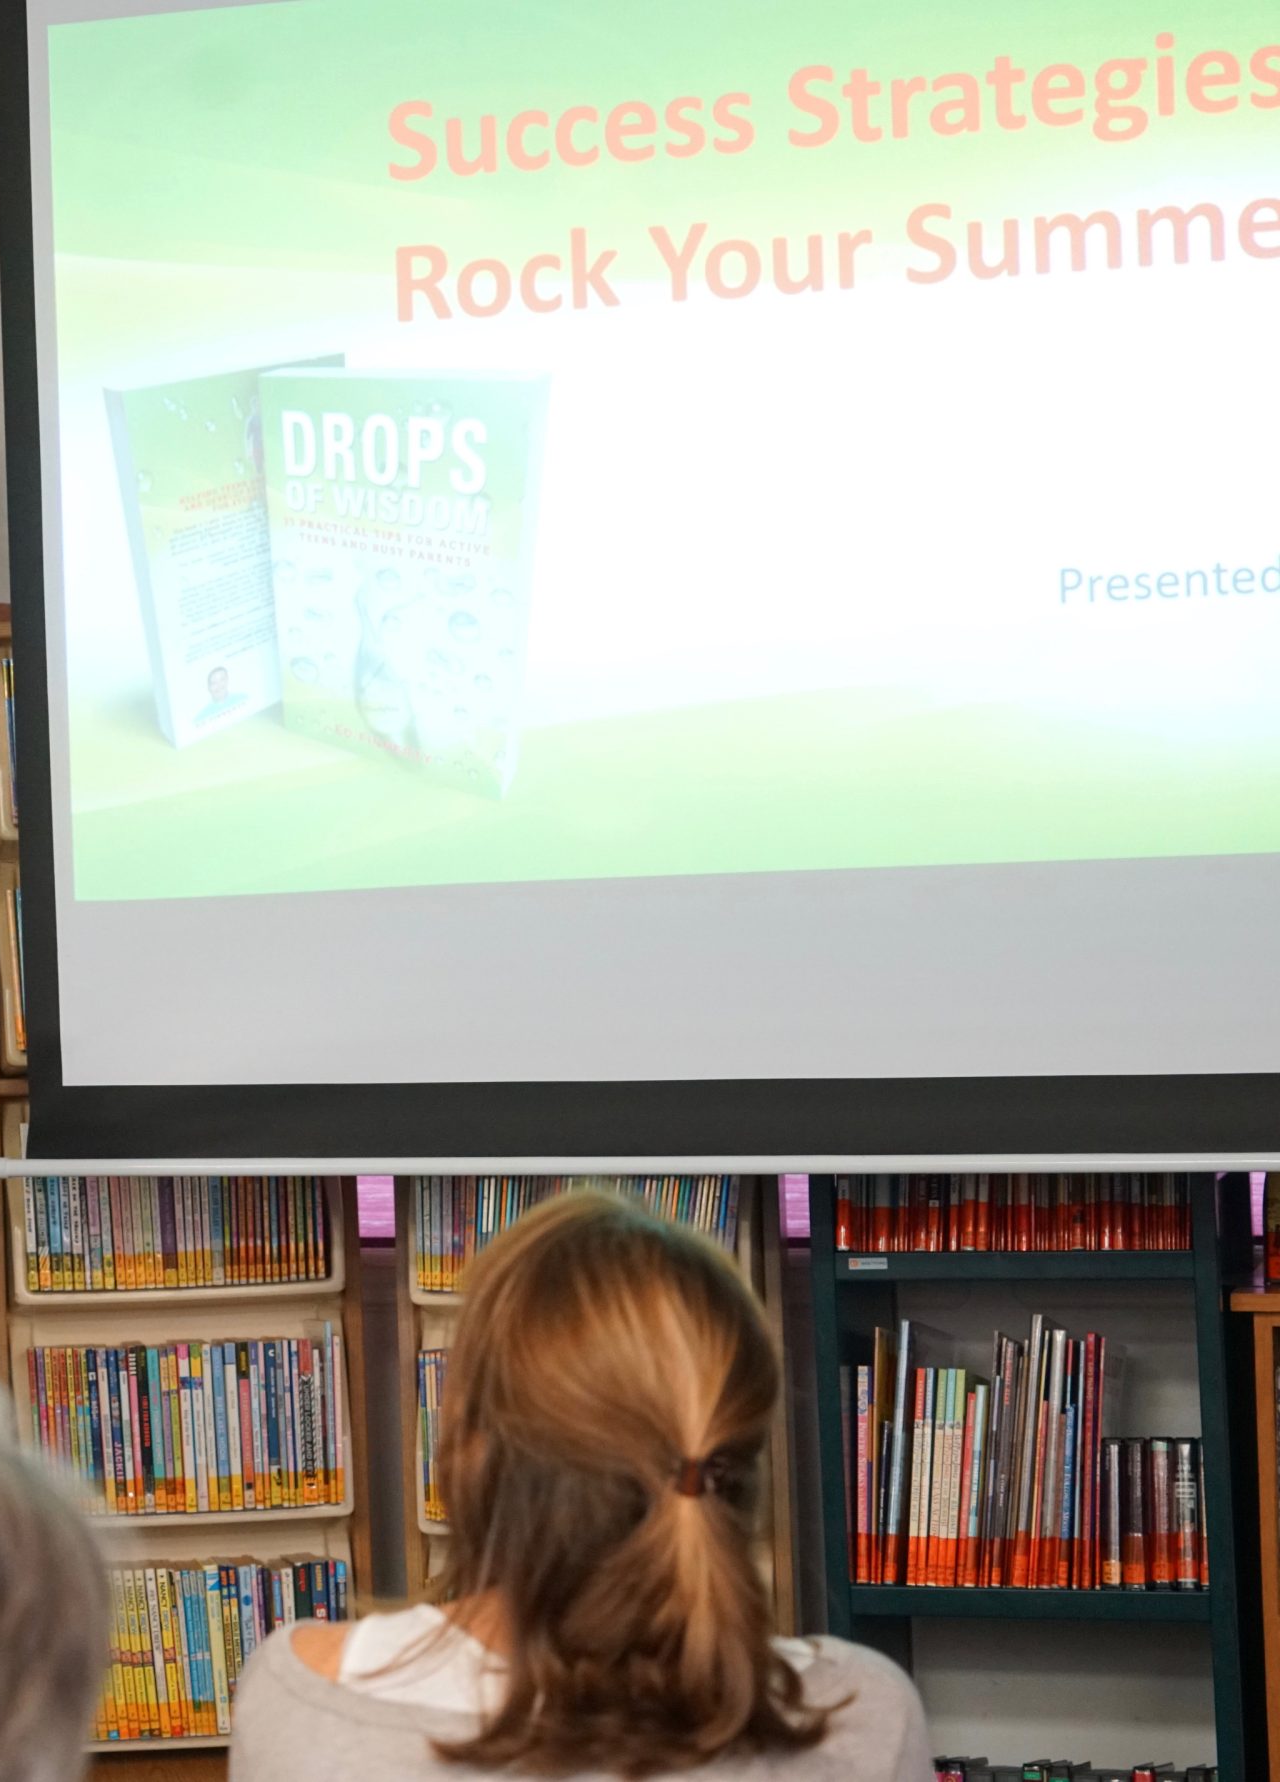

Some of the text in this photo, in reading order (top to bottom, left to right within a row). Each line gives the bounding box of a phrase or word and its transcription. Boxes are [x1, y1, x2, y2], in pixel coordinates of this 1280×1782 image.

[387, 31, 1280, 181] Success Strategies
[395, 227, 621, 323] Rock
[648, 220, 873, 302] Your
[281, 409, 488, 496] DROPS
[286, 479, 325, 513] OF
[332, 484, 492, 537] WISDOM
[299, 517, 369, 538] PRACTICAL
[373, 528, 402, 543] TIPS
[407, 532, 433, 547] FOR
[438, 538, 491, 556] ACTIVE
[299, 531, 337, 547] TEENS
[339, 538, 368, 551] AND
[409, 548, 472, 568] PARENTS
[1060, 553, 1280, 604] Presented
[303, 1384, 311, 1411] UNDER
[304, 1412, 312, 1442] LOCKER
[126, 1586, 135, 1612] NANCY
[137, 1585, 146, 1611] NANCY
[160, 1581, 168, 1608] NANCY
